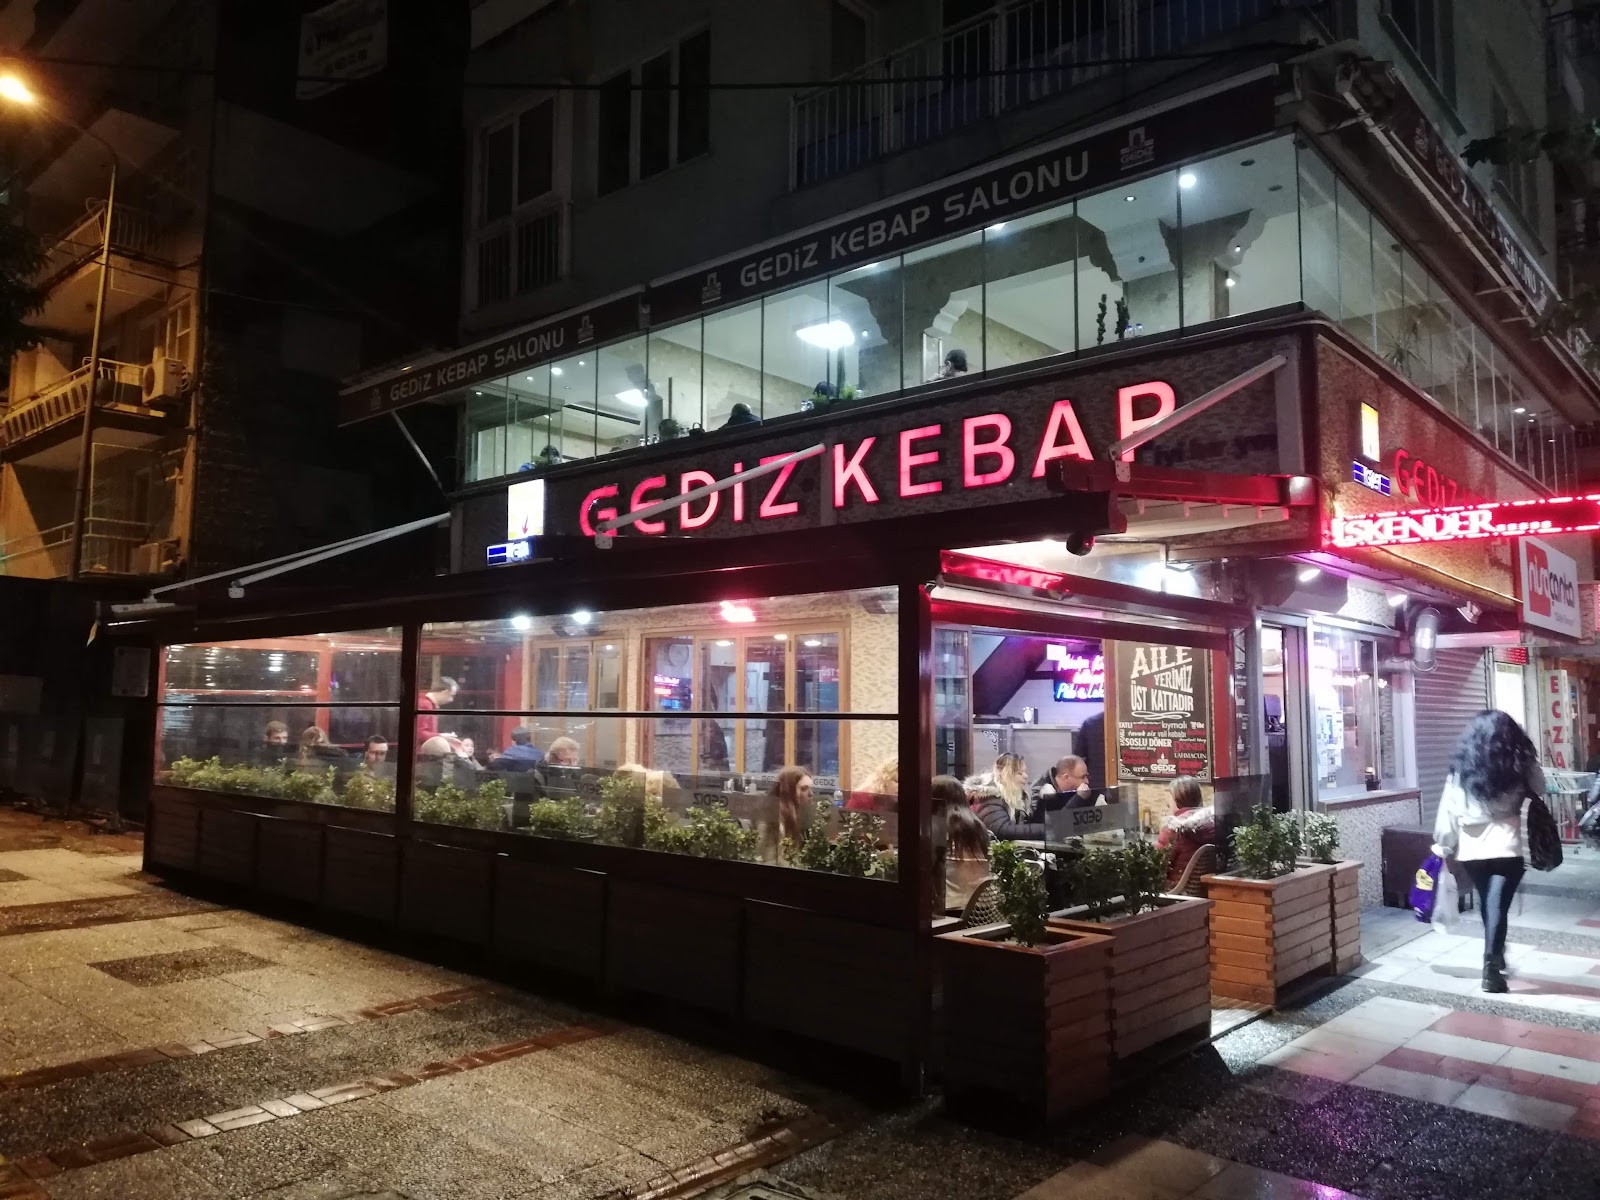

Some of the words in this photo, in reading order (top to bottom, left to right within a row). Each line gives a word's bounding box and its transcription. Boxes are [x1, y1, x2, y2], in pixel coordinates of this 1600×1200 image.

[830, 206, 932, 260] KEBAP
[943, 151, 1091, 224] SALONU
[437, 354, 489, 388] KEBAP
[494, 327, 565, 369] SALONU
[832, 380, 1177, 508] KEBAP
[1130, 680, 1148, 712] ÜST
[1151, 688, 1194, 712] KATTADIR
[1153, 664, 1194, 693] YERİMİZ
[1125, 738, 1148, 747] SOSLU
[1149, 737, 1172, 748] DÖNER
